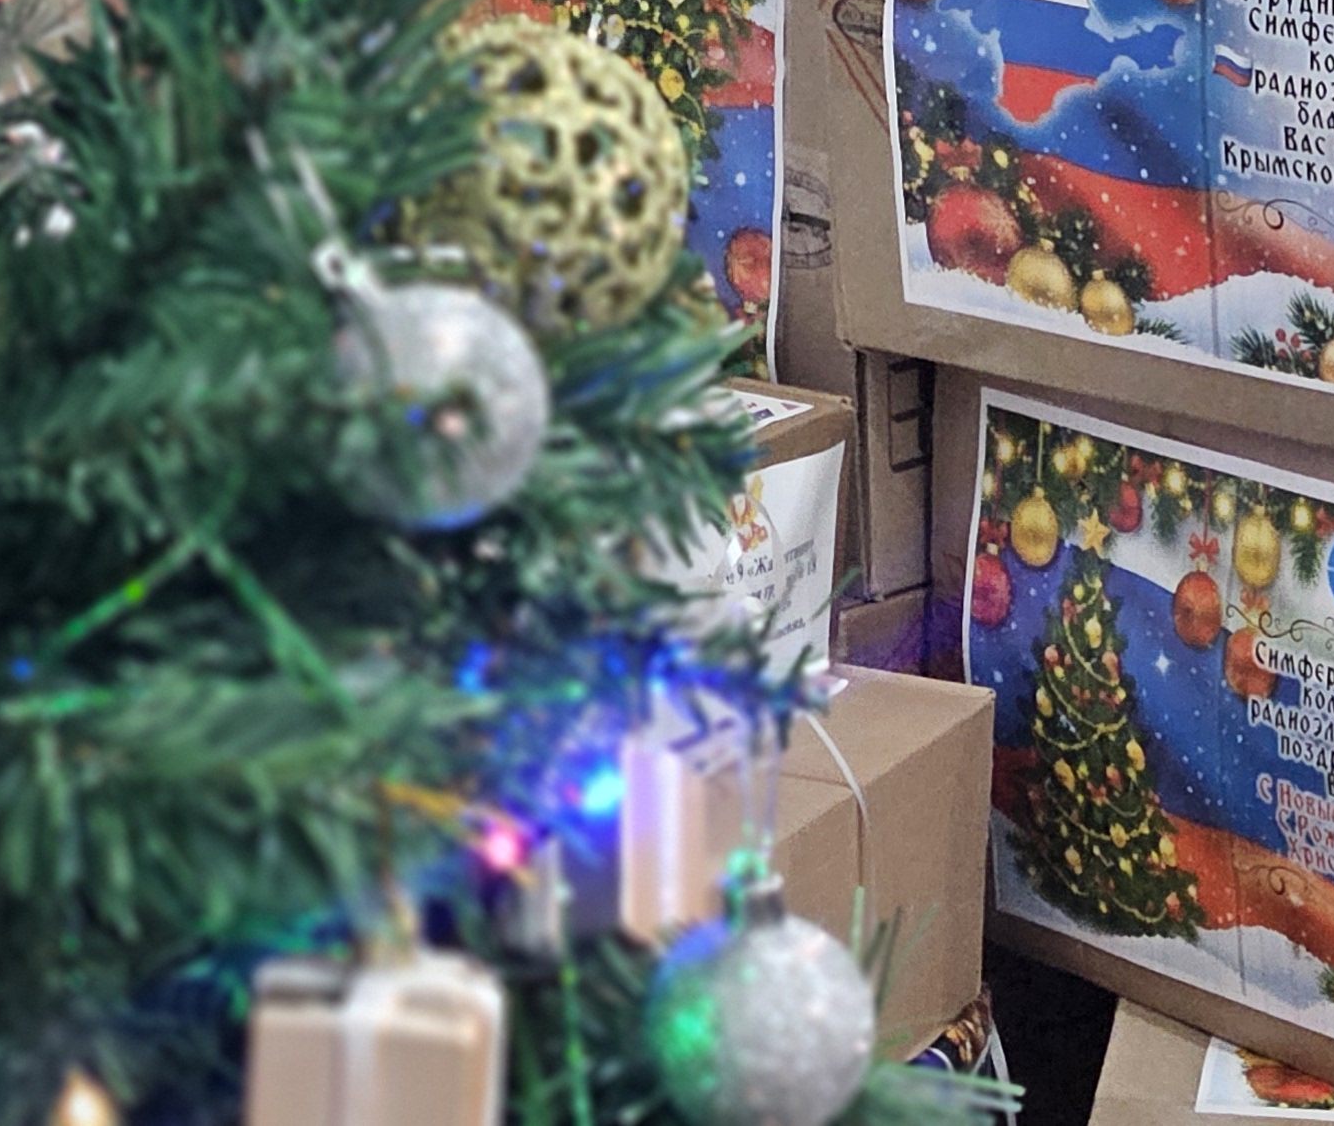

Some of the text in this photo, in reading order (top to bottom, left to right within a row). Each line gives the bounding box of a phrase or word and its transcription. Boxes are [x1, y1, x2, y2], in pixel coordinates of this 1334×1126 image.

[1283, 125, 1327, 156] Вас
[1258, 777, 1272, 802] С
[1277, 808, 1290, 831] С
